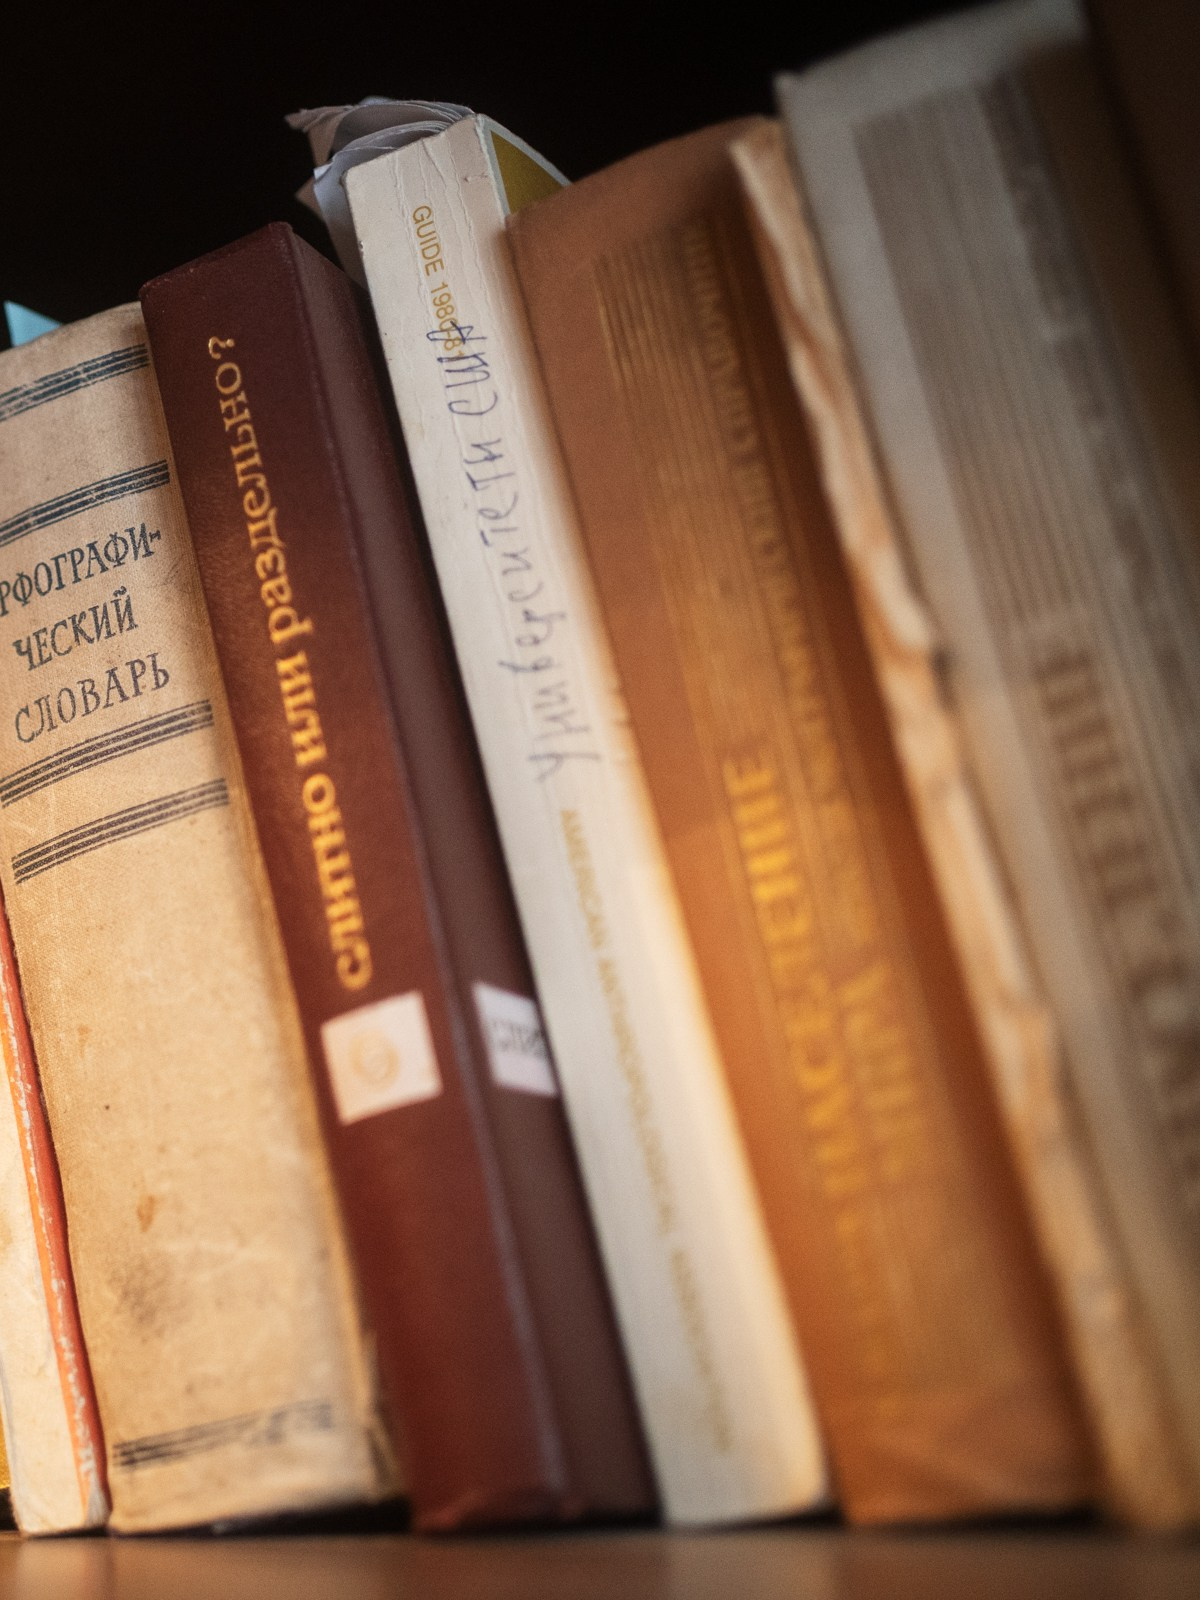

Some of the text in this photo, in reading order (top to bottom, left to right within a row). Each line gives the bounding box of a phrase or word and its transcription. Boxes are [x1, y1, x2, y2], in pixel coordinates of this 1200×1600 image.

[411, 204, 445, 278] GUIDE
[426, 320, 498, 416] США
[207, 335, 315, 645] раздельно?
[12, 585, 138, 671] ЧЕСКИЙ
[14, 652, 171, 743] СЛОВАРЬ
[275, 649, 329, 768] или
